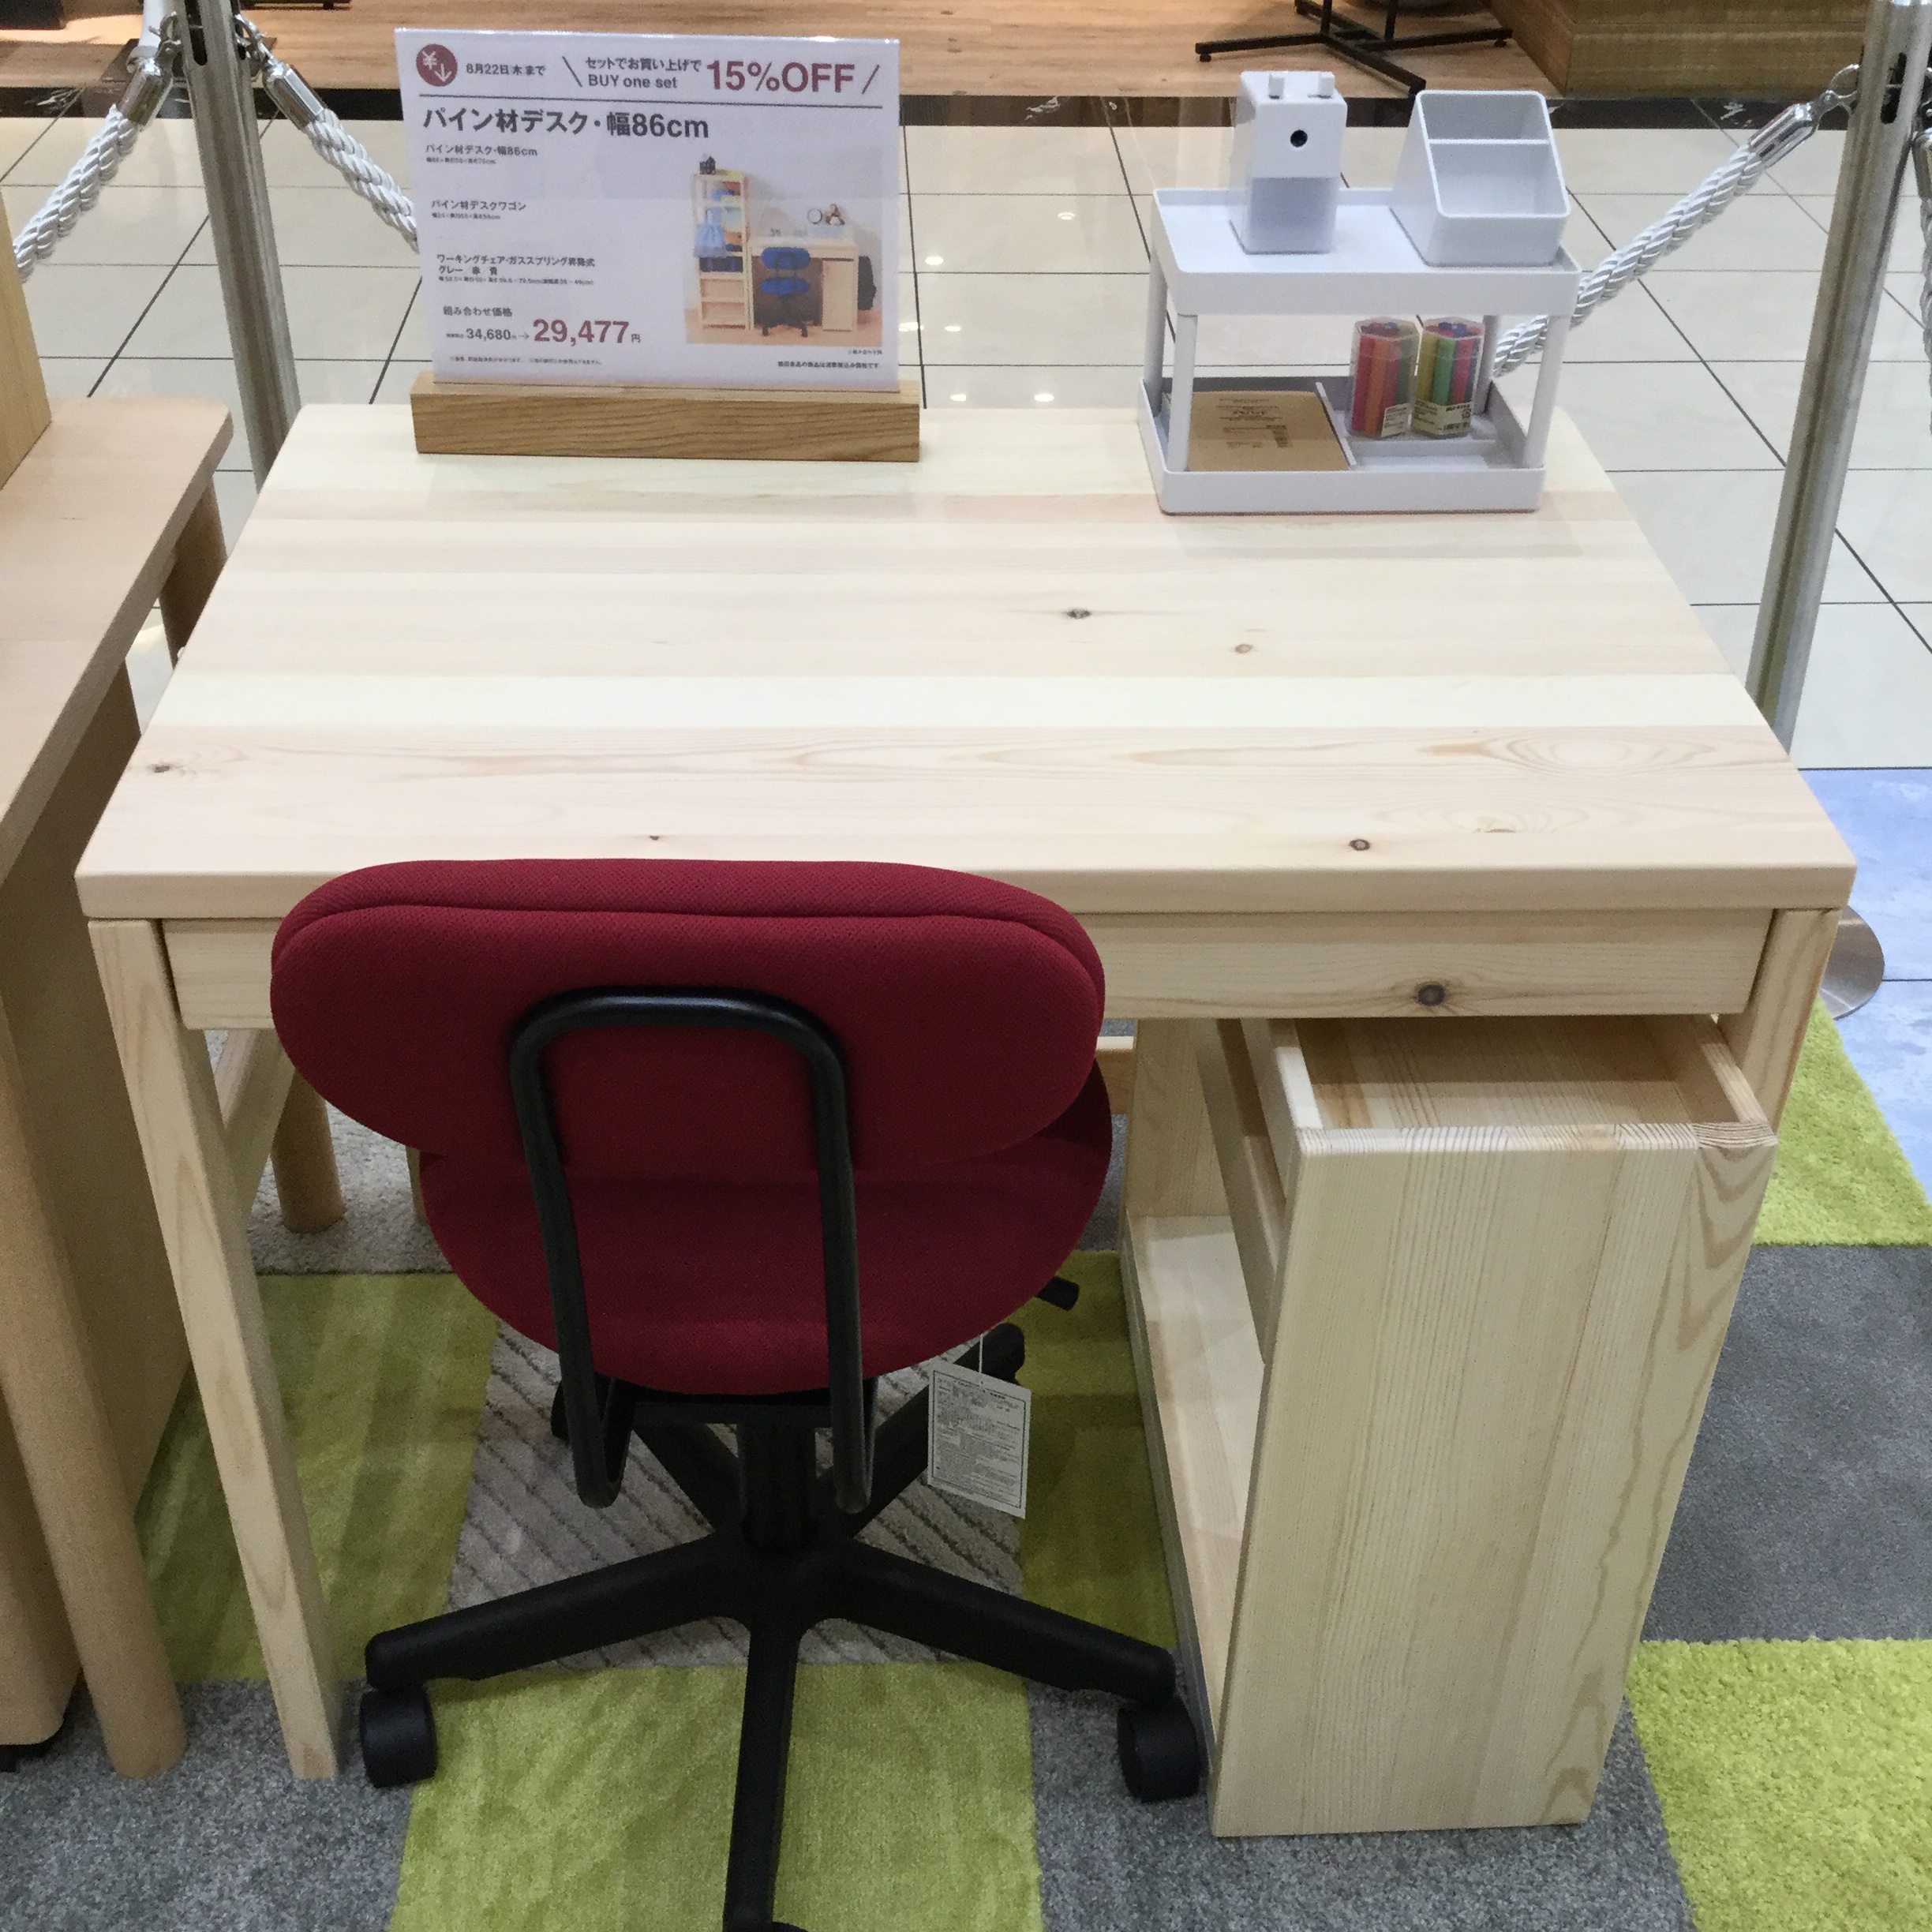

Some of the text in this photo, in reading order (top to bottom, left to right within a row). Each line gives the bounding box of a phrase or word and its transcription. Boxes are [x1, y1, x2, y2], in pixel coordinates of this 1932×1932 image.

[585, 56, 702, 72] セットでお買い上げで
[588, 74, 677, 88] BUY one set
[706, 59, 856, 92] 15%OFF
[466, 328, 511, 342] 34,680
[533, 318, 629, 346] 29,477
